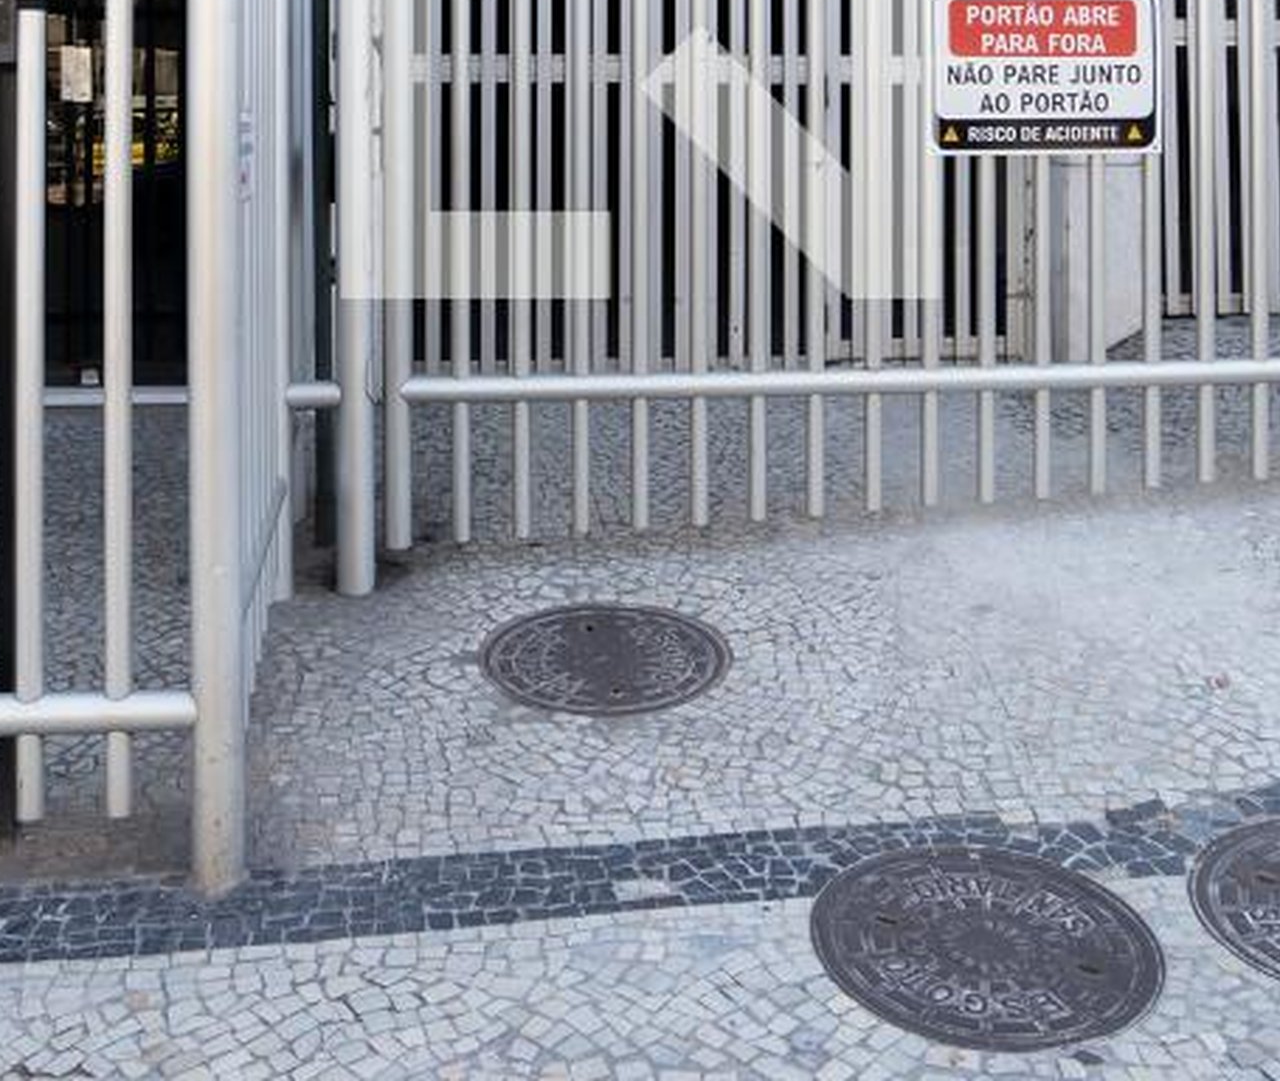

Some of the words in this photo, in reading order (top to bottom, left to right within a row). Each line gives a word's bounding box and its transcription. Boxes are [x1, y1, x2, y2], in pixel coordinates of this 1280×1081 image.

[966, 2, 1054, 26] PORTÃO
[1064, 5, 1121, 26] ABRE
[981, 33, 1040, 54] PARA
[1048, 33, 1107, 54] FORA
[946, 62, 994, 85] NÃO
[1003, 64, 1060, 85] PARE
[1069, 64, 1142, 85] JUNTO
[979, 93, 1011, 114] AO
[1020, 90, 1110, 113] PORTÃO
[967, 126, 1017, 143] RISCO
[1021, 126, 1041, 142] DE
[1044, 126, 1120, 142] ACIDENTE
